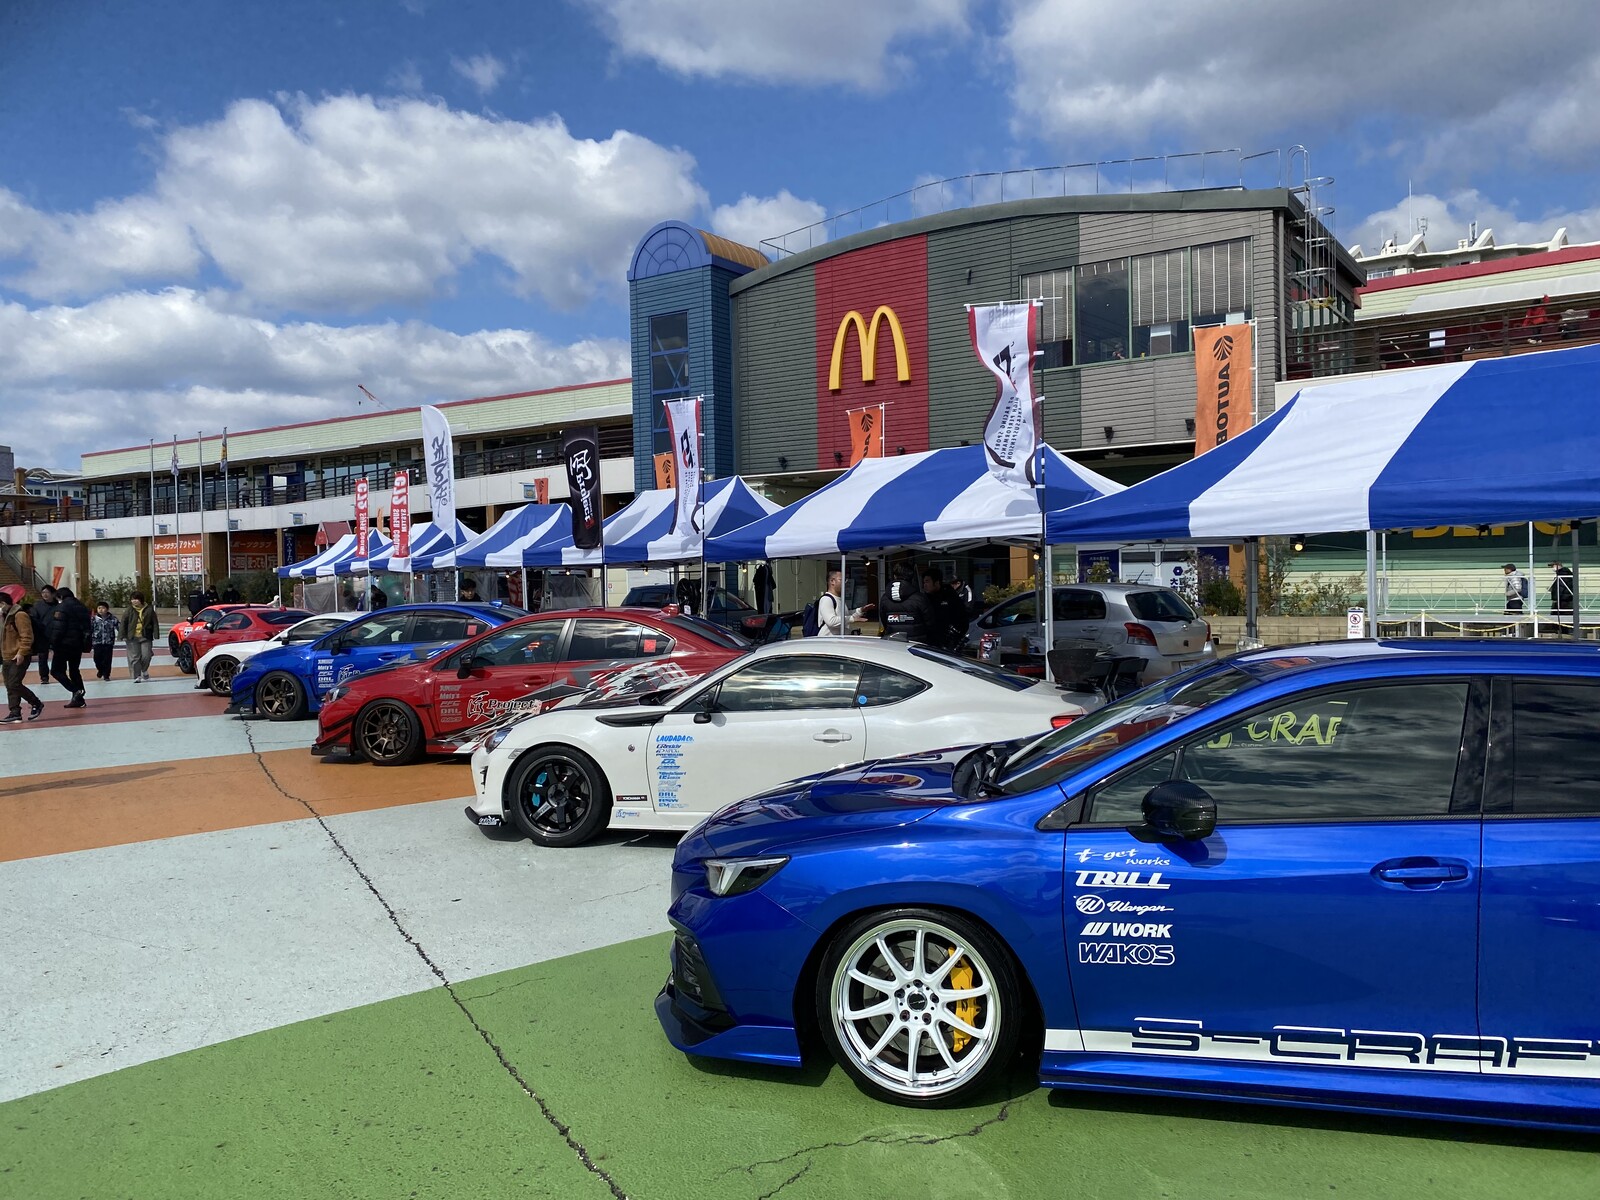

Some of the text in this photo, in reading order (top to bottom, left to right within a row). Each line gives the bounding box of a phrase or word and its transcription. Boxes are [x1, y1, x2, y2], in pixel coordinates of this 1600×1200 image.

[486, 698, 536, 712] Project
[1125, 856, 1171, 866] works
[1075, 870, 1172, 890] TRILL
[1112, 922, 1174, 938] WORK
[1131, 1016, 1600, 1069] S-CRAF
